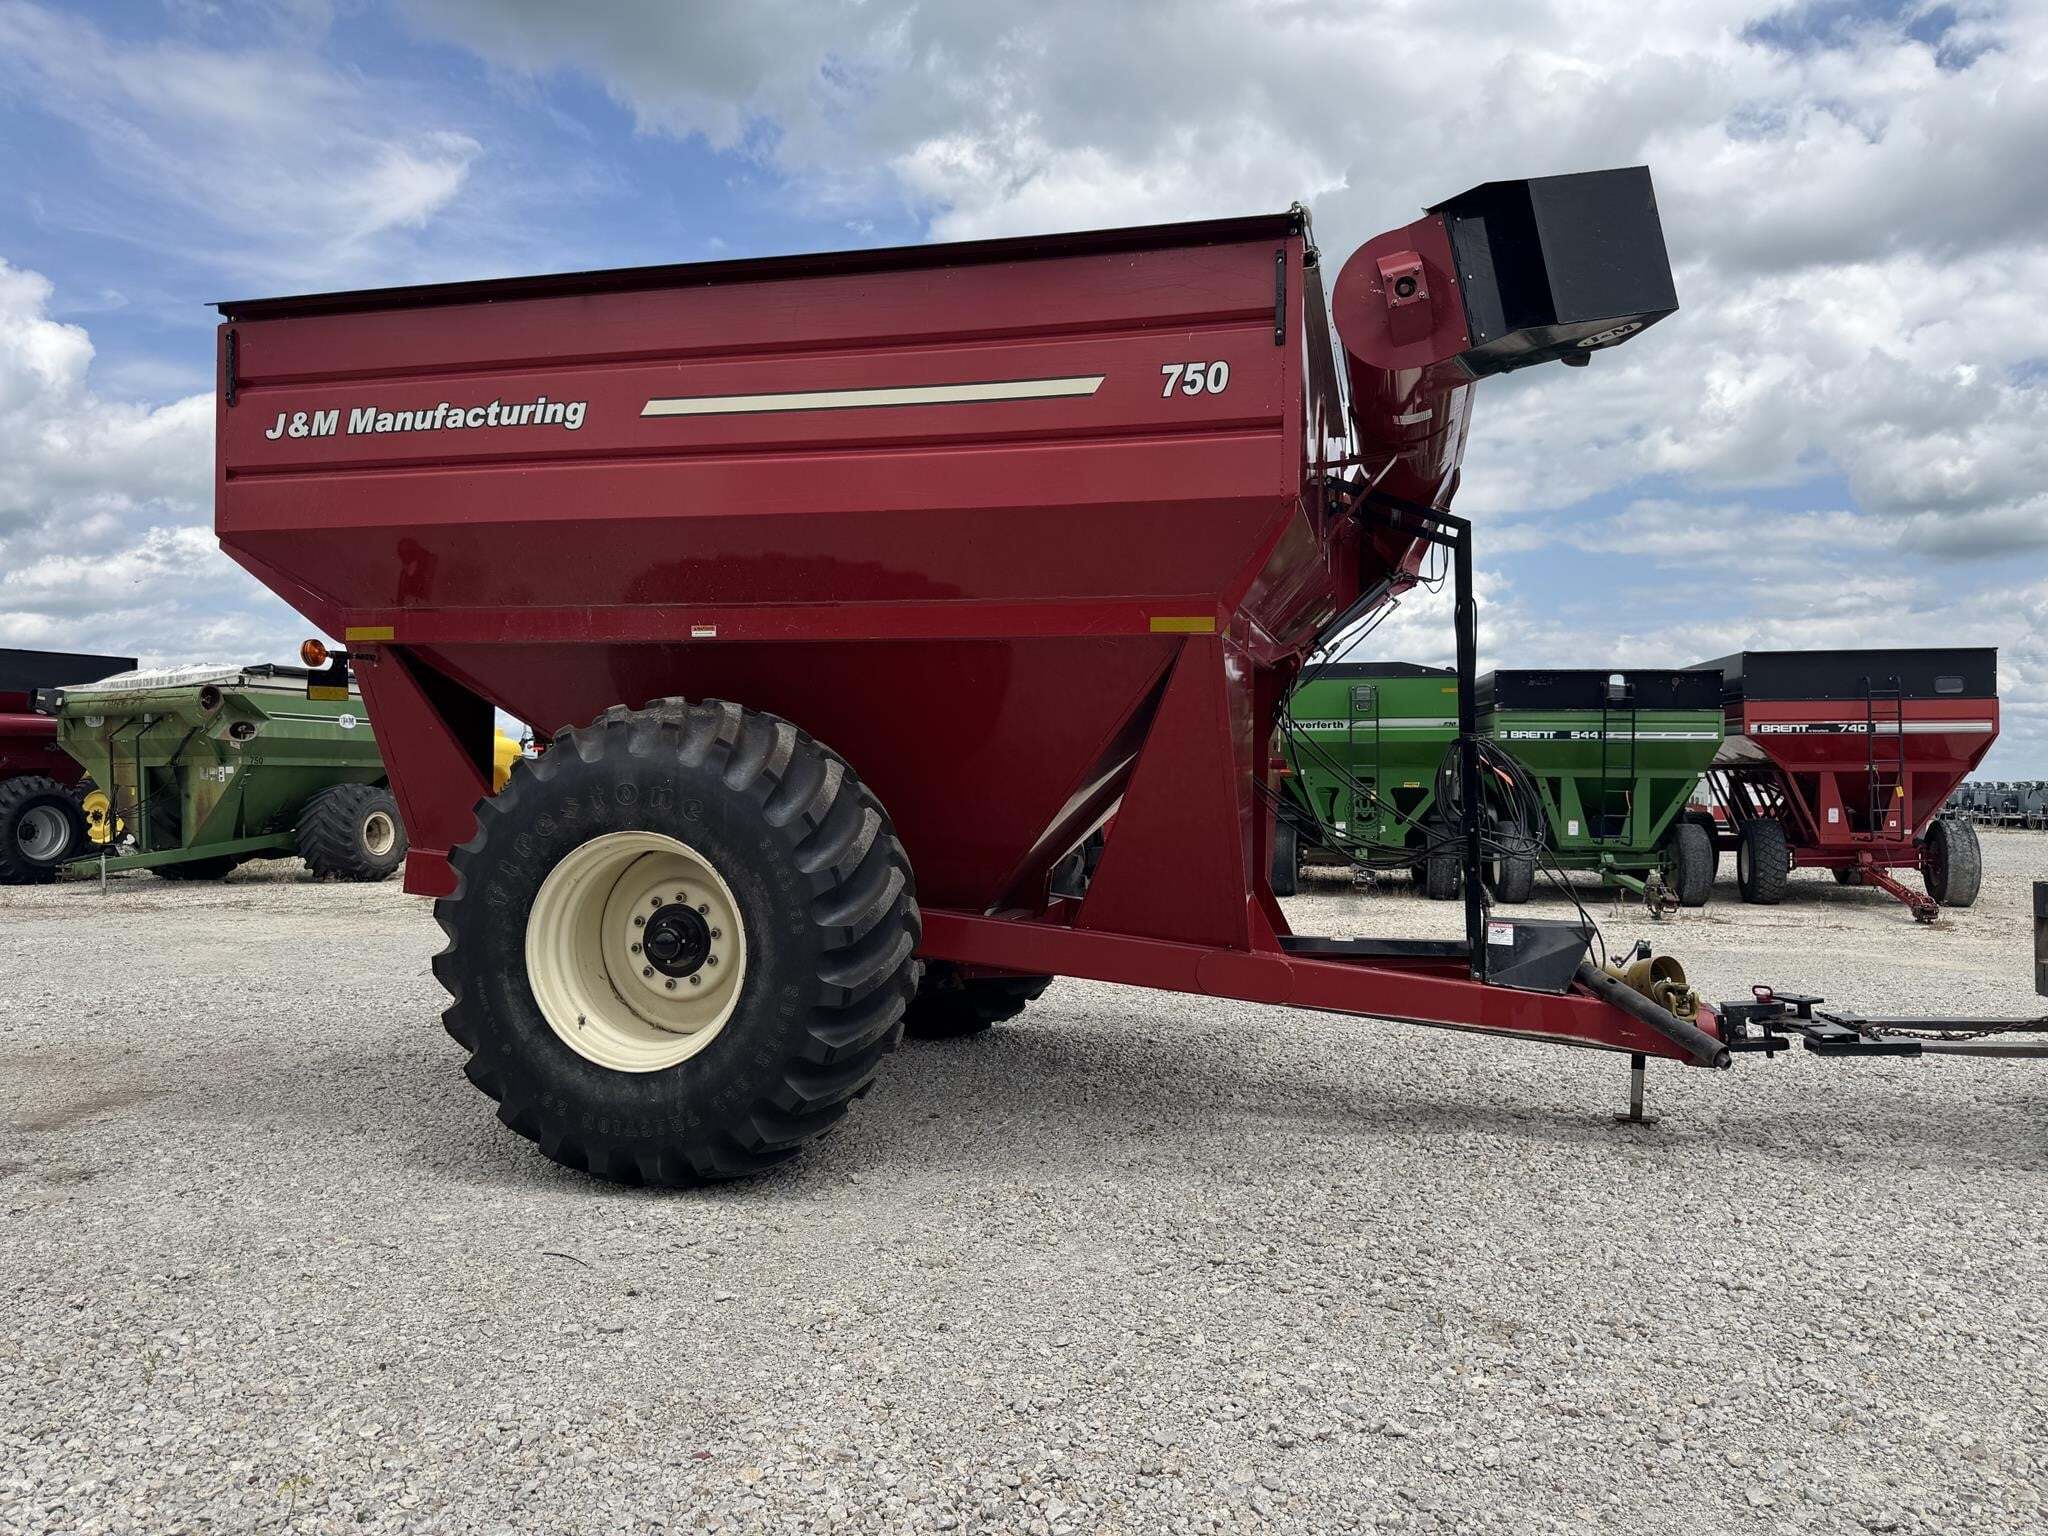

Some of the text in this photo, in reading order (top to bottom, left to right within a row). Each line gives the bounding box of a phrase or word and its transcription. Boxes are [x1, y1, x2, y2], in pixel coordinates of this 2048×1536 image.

[1161, 360, 1230, 398] 750
[265, 397, 588, 440] J&M Manufacturing
[1510, 730, 1599, 739] BRENT 544
[1761, 724, 1809, 733] BRENT
[1838, 724, 1868, 733] 740
